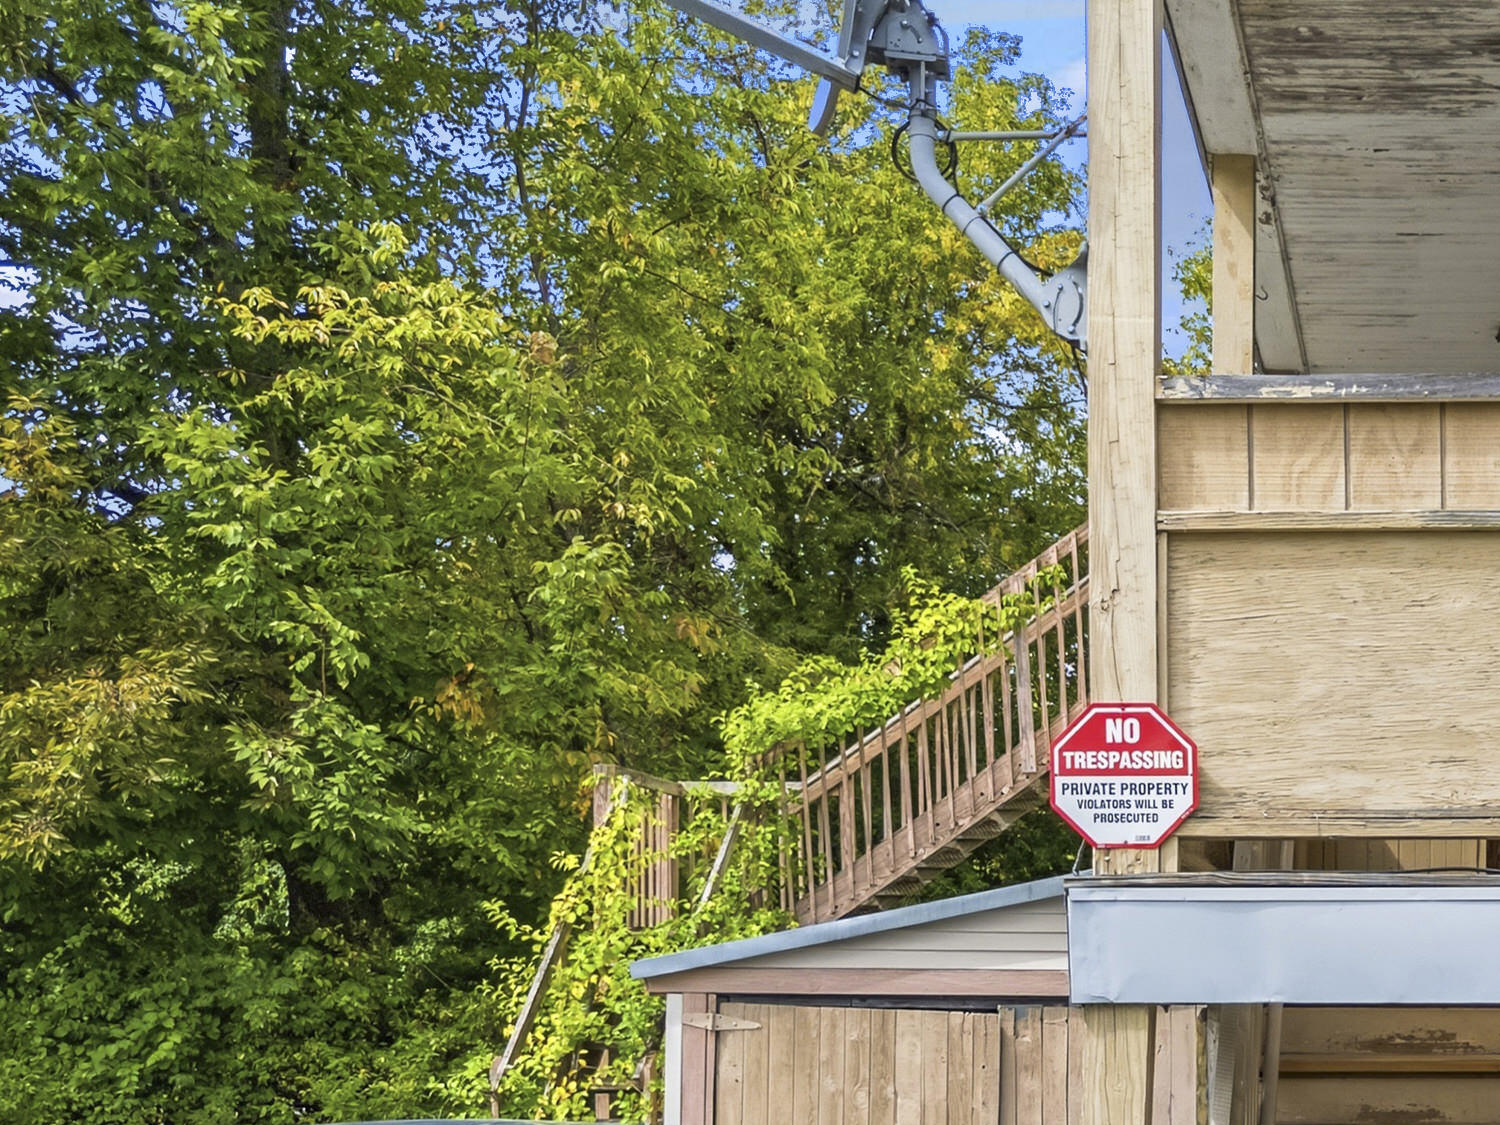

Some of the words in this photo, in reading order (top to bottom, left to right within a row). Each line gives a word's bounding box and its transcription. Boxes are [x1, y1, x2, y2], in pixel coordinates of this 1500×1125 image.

[1105, 718, 1140, 744] NO
[1062, 750, 1184, 769] TRESPASSING
[1061, 782, 1116, 796] PRIVATE
[1120, 782, 1189, 796] PROPERTY
[1077, 799, 1132, 809] VIOLATORS
[1135, 799, 1158, 809] WILL
[1161, 799, 1175, 809] BE
[1093, 812, 1159, 823] PROSECUTED
